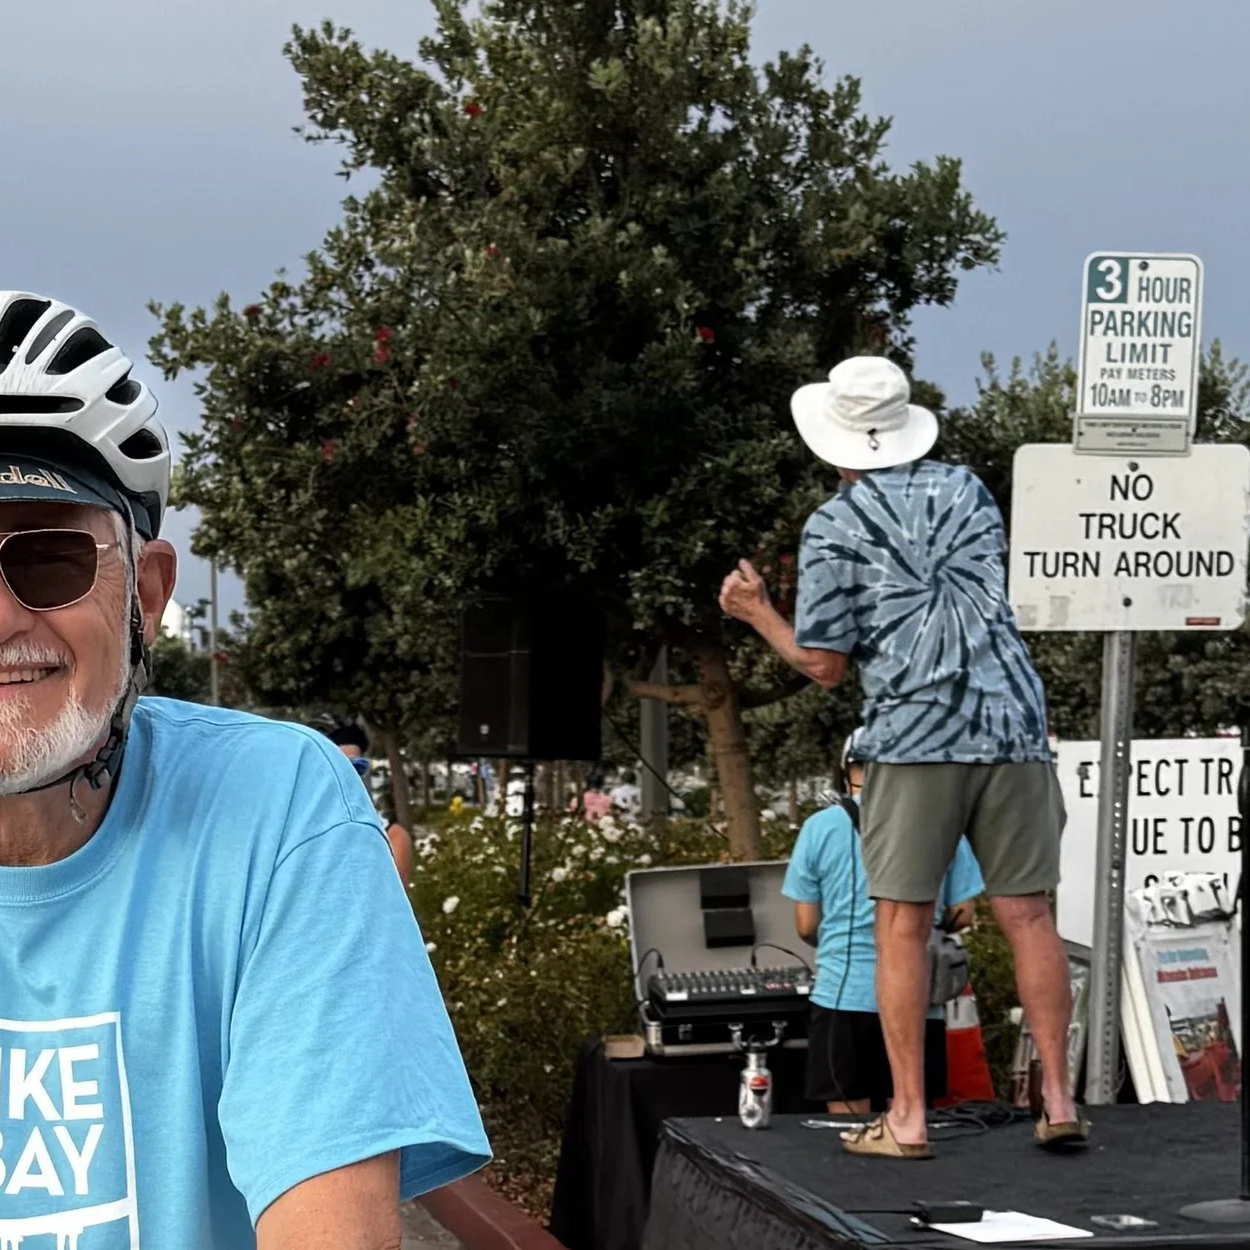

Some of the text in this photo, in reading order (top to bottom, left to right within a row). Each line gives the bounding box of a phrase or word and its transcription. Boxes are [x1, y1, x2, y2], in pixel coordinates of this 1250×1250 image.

[1095, 259, 1192, 304] 3 HOUR
[1089, 310, 1193, 338] PARKING
[1105, 343, 1173, 364] LIMIT
[1100, 367, 1177, 381] PAY METERS
[1090, 383, 1131, 407] 10AM
[1150, 384, 1184, 408] 8PM
[1110, 473, 1153, 501] NO
[1079, 512, 1181, 541] TRUCK
[1023, 551, 1235, 578] TURN AROUND
[1079, 757, 1234, 798] EECT TR
[1132, 816, 1242, 856] UE TO B
